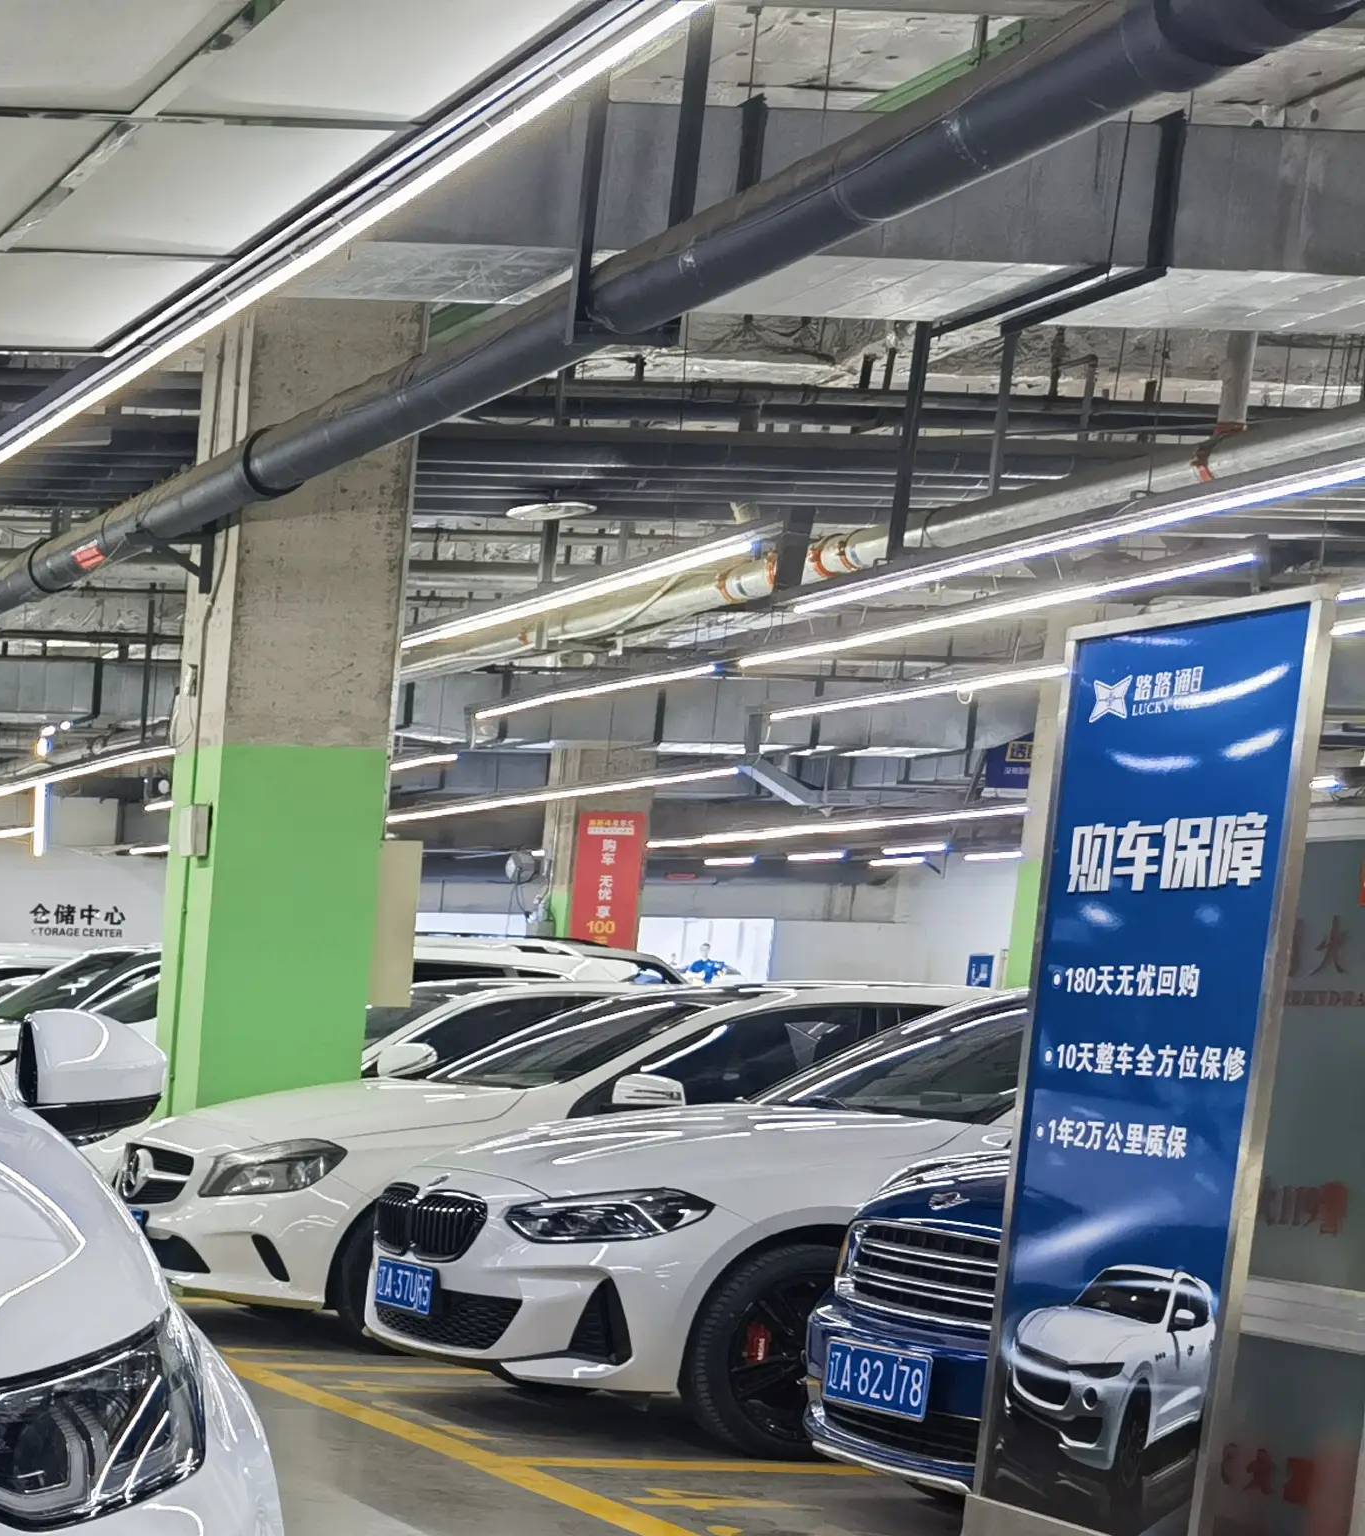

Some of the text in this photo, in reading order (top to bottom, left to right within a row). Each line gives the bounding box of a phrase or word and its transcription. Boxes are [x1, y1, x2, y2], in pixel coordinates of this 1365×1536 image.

[1134, 670, 1191, 701] 路路通
[1132, 702, 1169, 716] LUCKY
[1067, 812, 1269, 893] 购车保障
[29, 903, 126, 925] 仓储中心
[82, 927, 123, 938] CENTER
[1065, 964, 1200, 998] 180天无忧回购
[1056, 1042, 1246, 1081] 10天整车全方位保修
[1048, 1117, 1188, 1159] 1年2万公里质保
